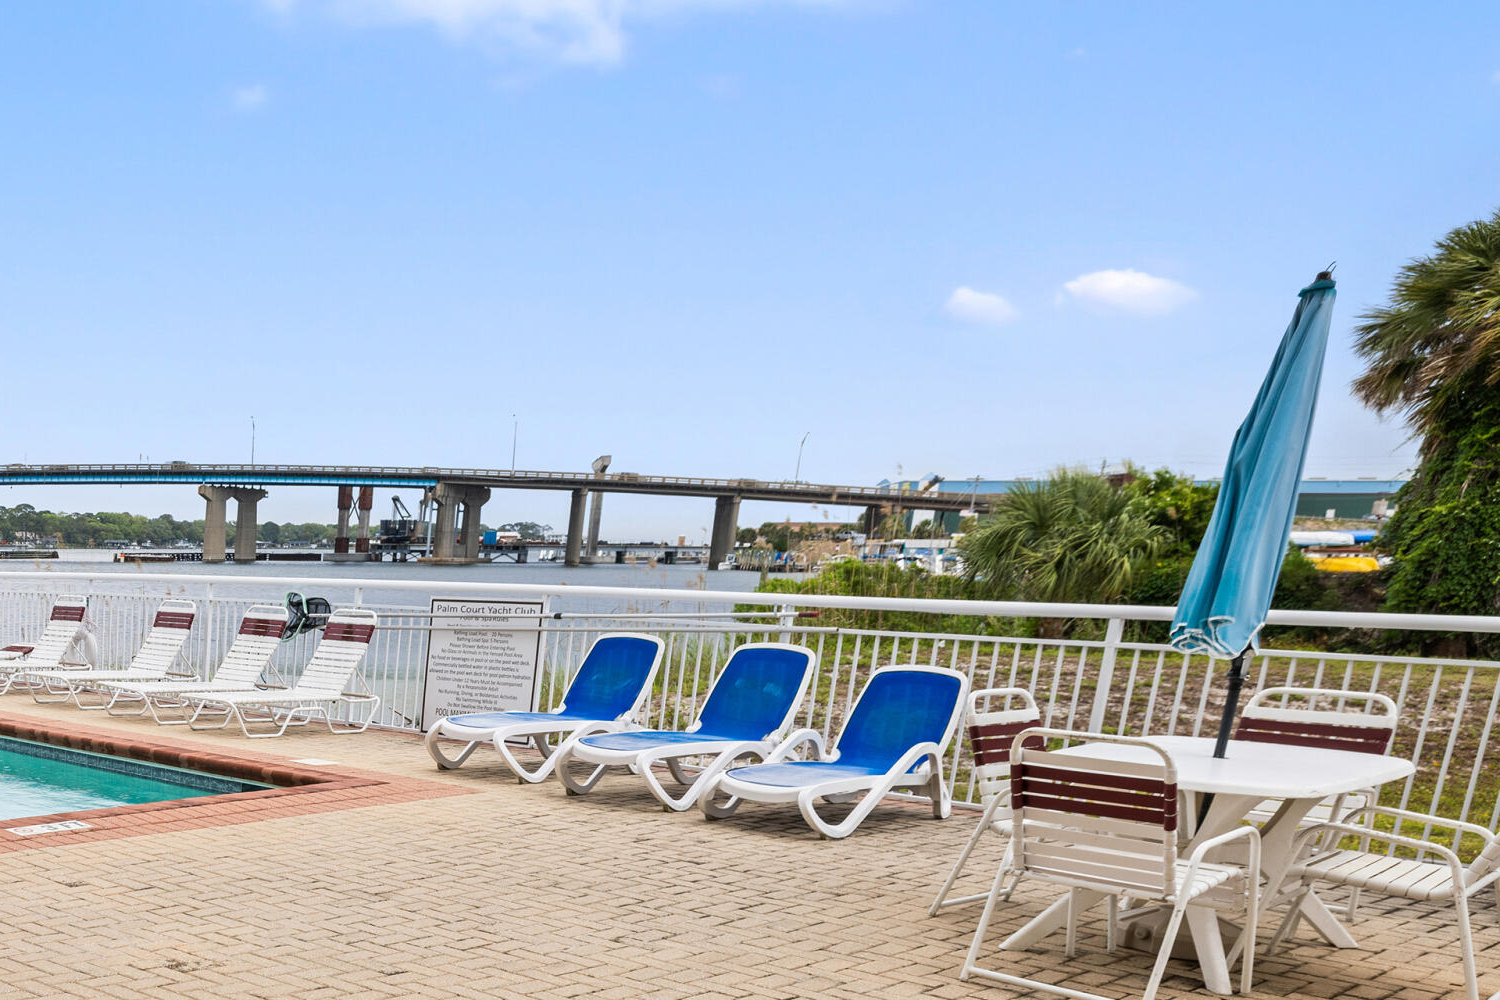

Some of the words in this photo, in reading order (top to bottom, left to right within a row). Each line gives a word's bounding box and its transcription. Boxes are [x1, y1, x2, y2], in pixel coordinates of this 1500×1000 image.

[437, 604, 457, 613] Palm
[460, 605, 484, 614] Court
[488, 606, 512, 614] Yacht
[436, 708, 449, 716] POOL
